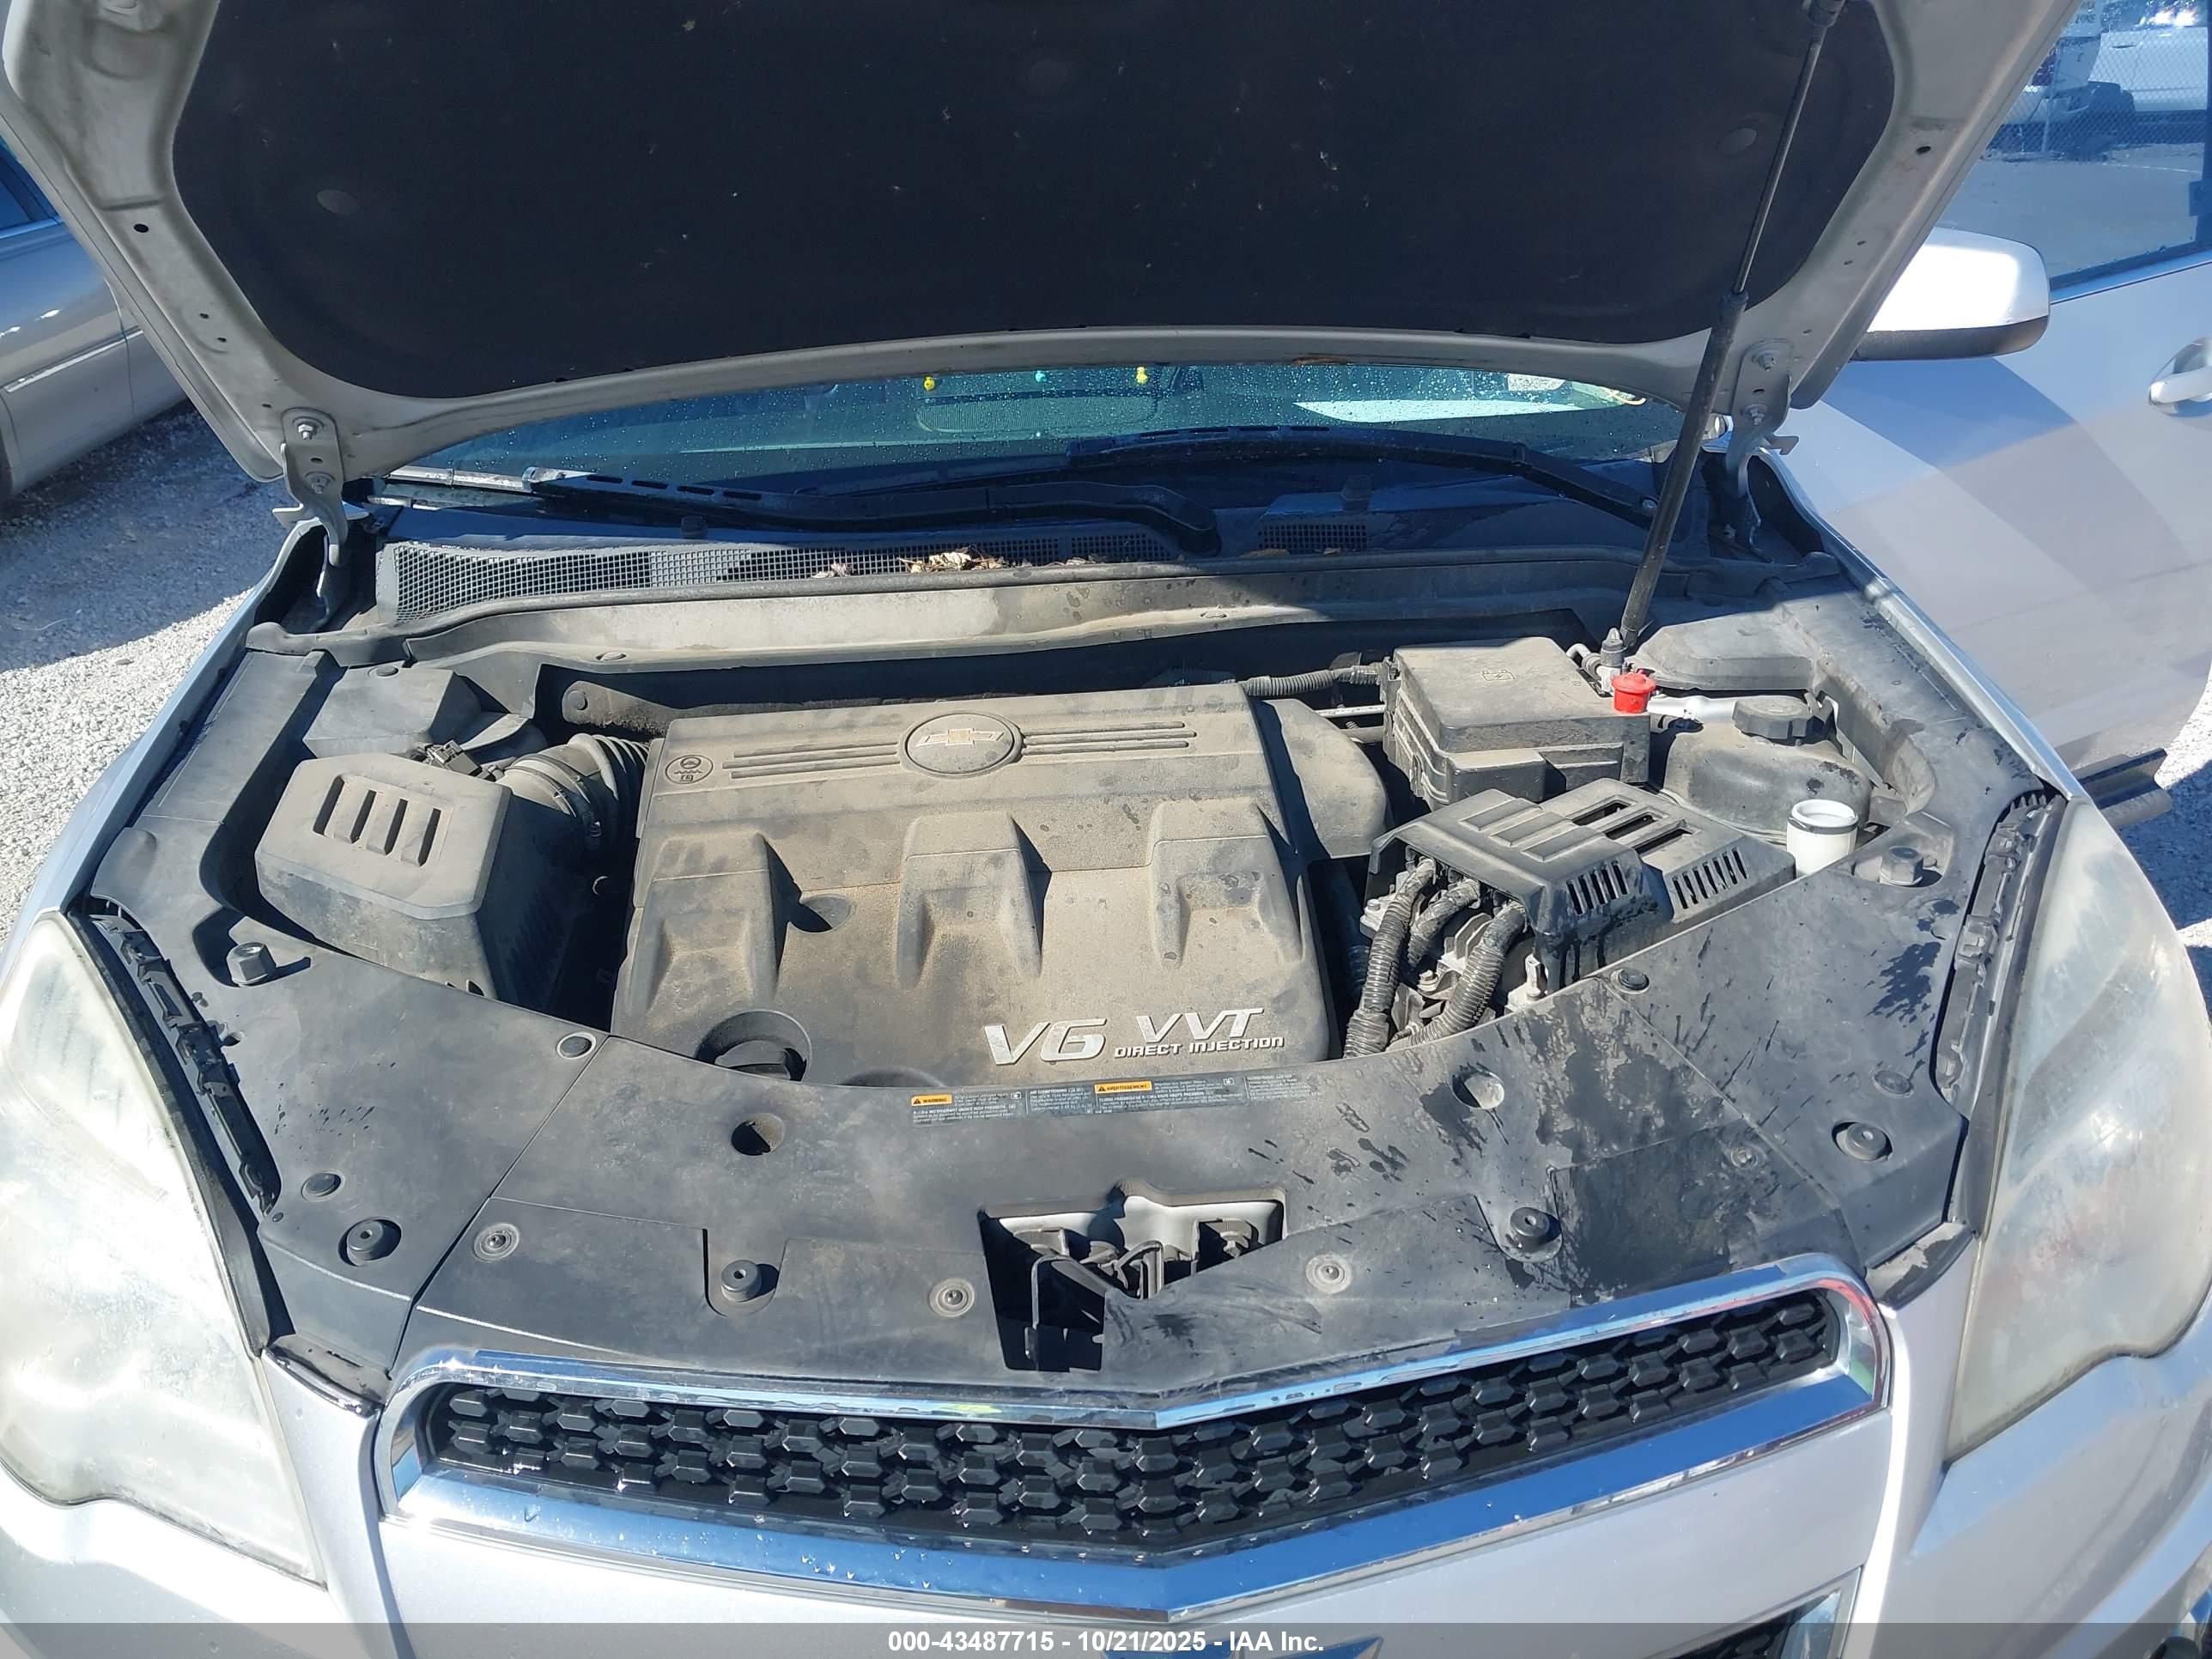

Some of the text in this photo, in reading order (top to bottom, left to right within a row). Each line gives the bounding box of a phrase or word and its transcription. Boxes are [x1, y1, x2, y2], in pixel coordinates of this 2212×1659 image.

[984, 1007, 1265, 1065] V6 VVT
[1114, 1036, 1285, 1058] DIRECT INJECTION
